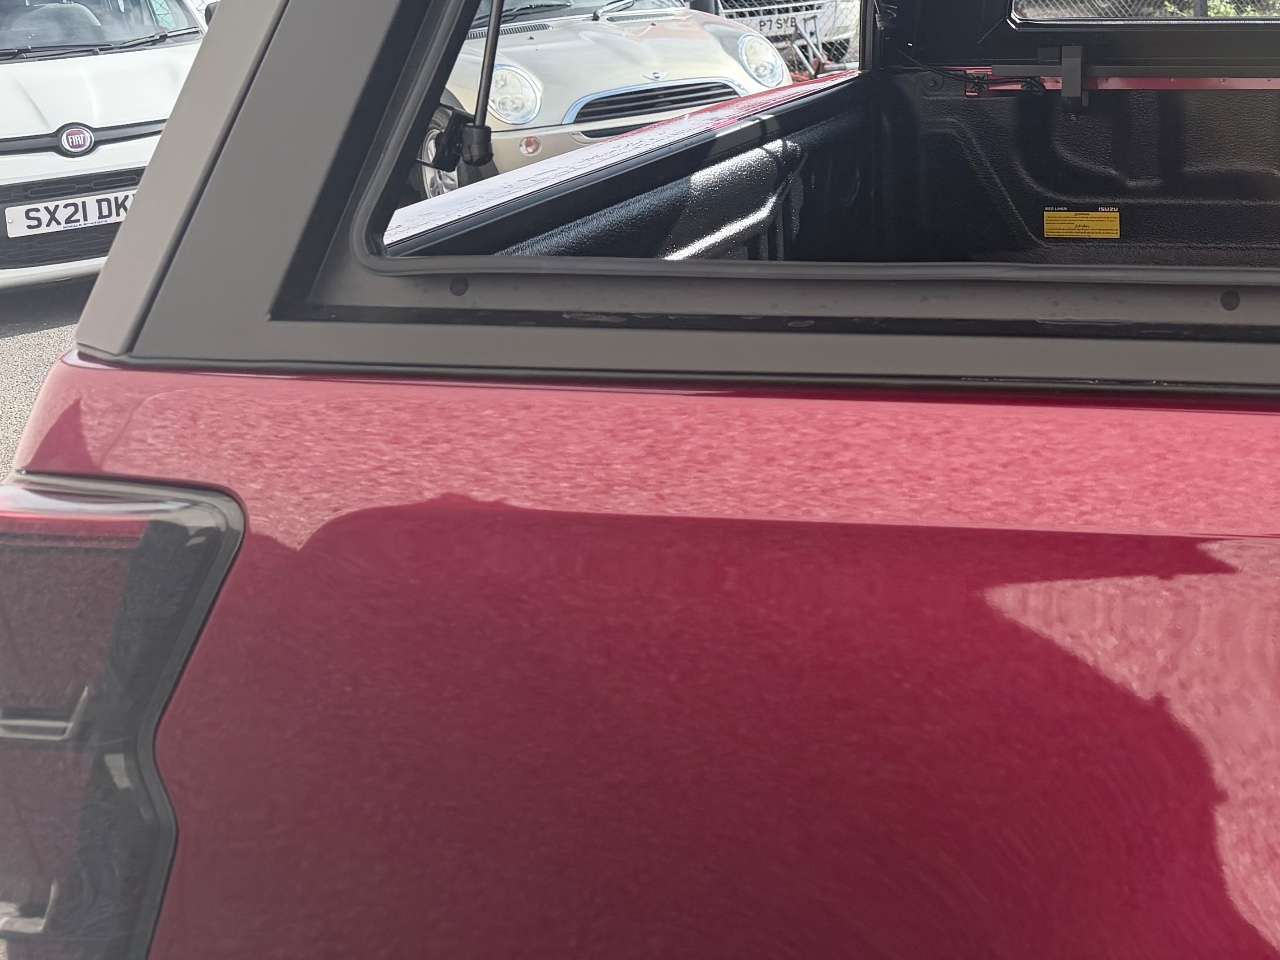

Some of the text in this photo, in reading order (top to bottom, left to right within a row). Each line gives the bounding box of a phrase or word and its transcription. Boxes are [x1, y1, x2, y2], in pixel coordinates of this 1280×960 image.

[68, 135, 84, 146] FIAT
[25, 194, 135, 229] SX21 DK
